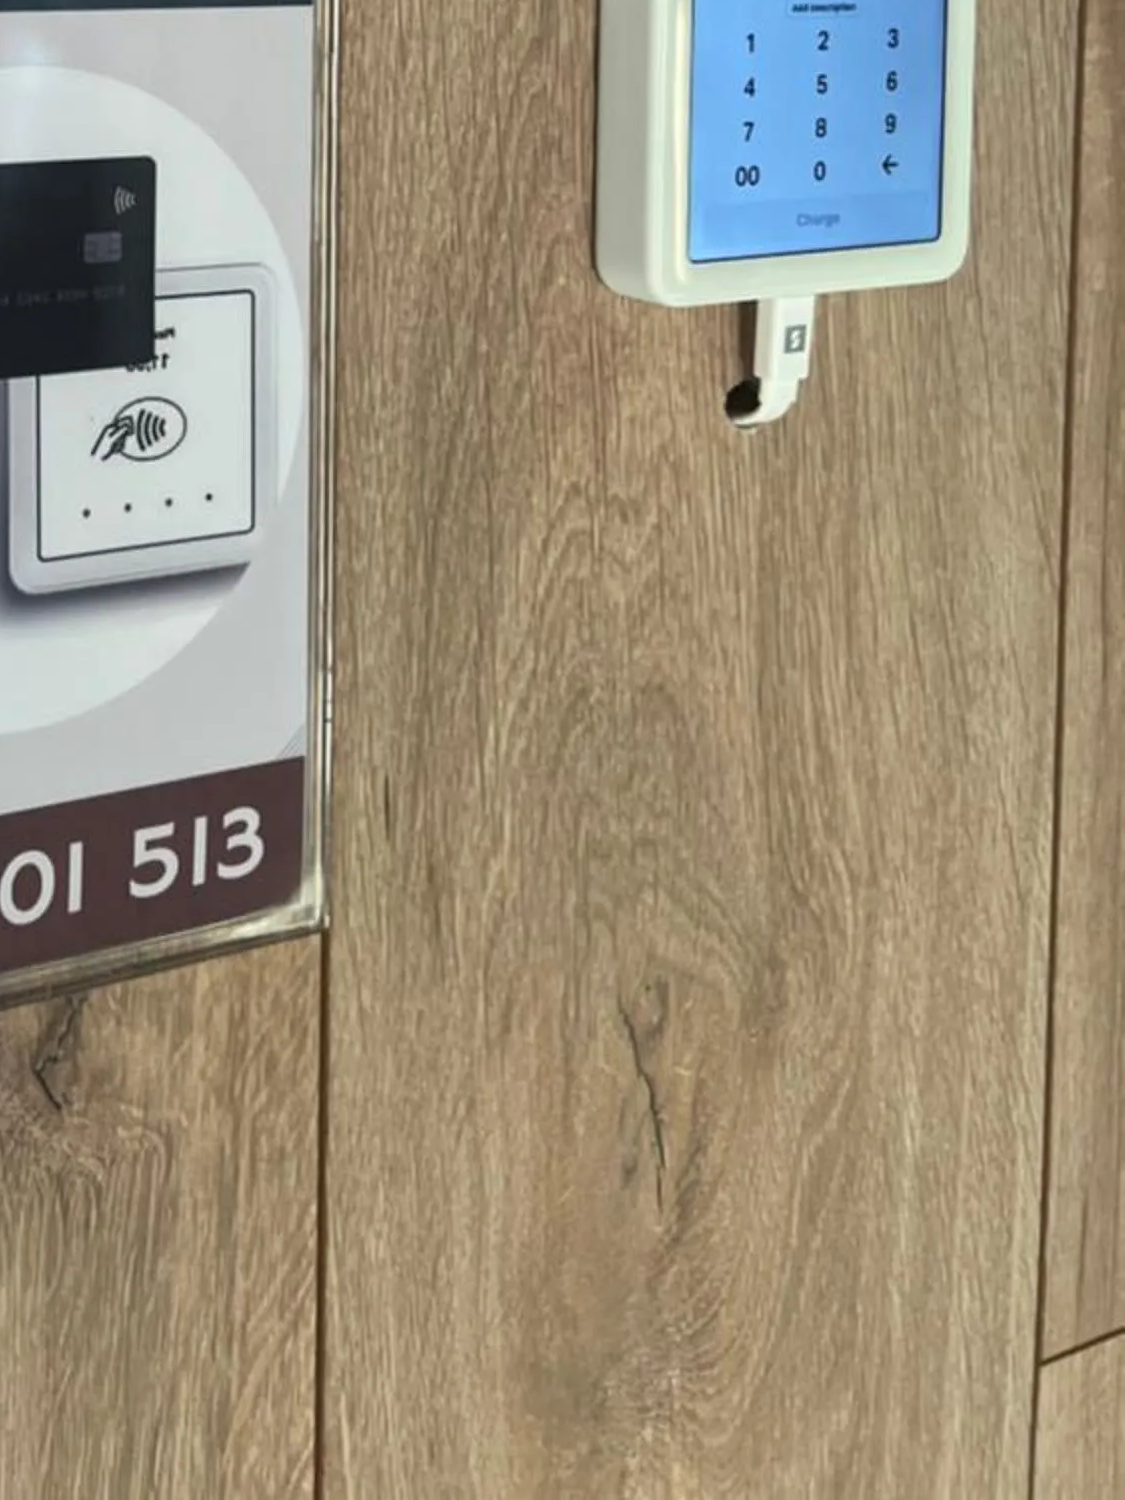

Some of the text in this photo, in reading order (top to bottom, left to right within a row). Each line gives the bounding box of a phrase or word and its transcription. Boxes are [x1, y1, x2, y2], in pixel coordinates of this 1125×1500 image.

[746, 27, 900, 54] 1 2 3
[743, 69, 899, 98] 4 5 6
[742, 112, 898, 143] 7 8 9
[734, 160, 827, 188] 00 0
[795, 212, 841, 229] Charge
[128, 805, 266, 899] 513
